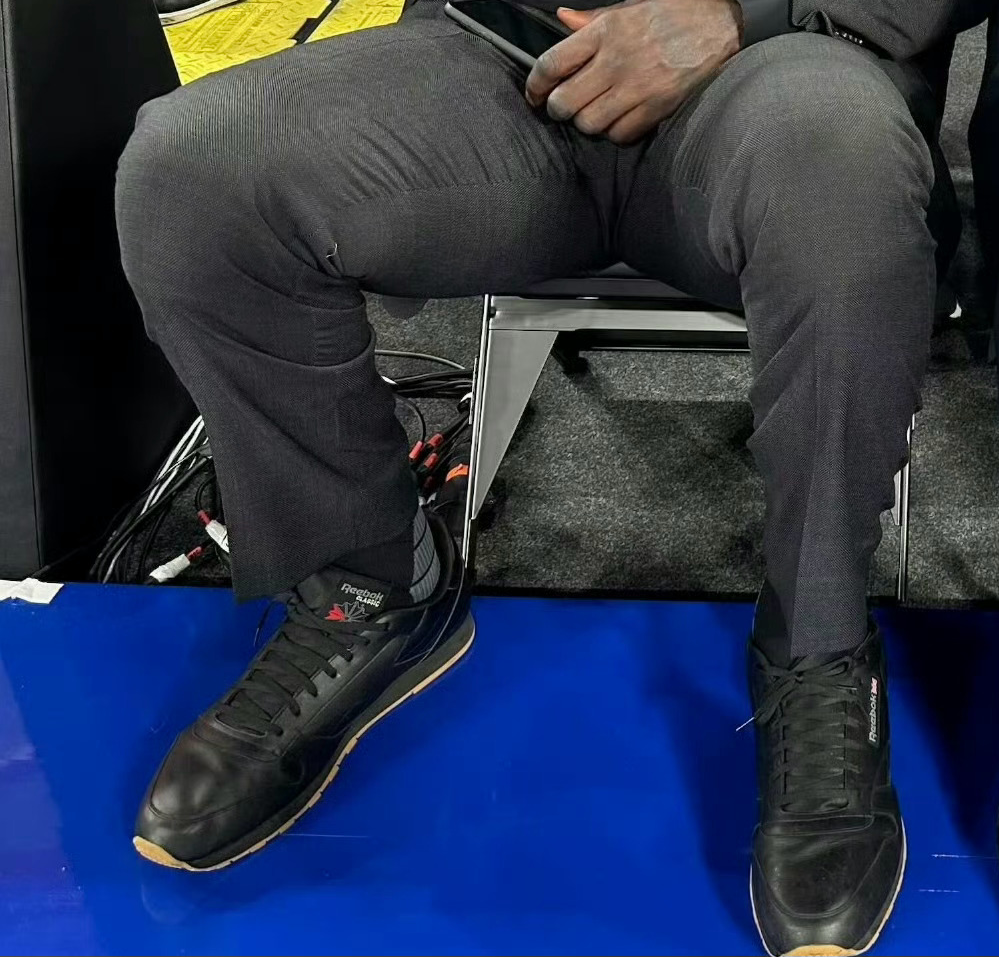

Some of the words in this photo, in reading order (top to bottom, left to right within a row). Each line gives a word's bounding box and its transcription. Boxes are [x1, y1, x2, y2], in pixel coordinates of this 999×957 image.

[341, 582, 384, 601] Reebok
[355, 595, 381, 608] CLASSIC
[868, 694, 877, 742] Reebok
